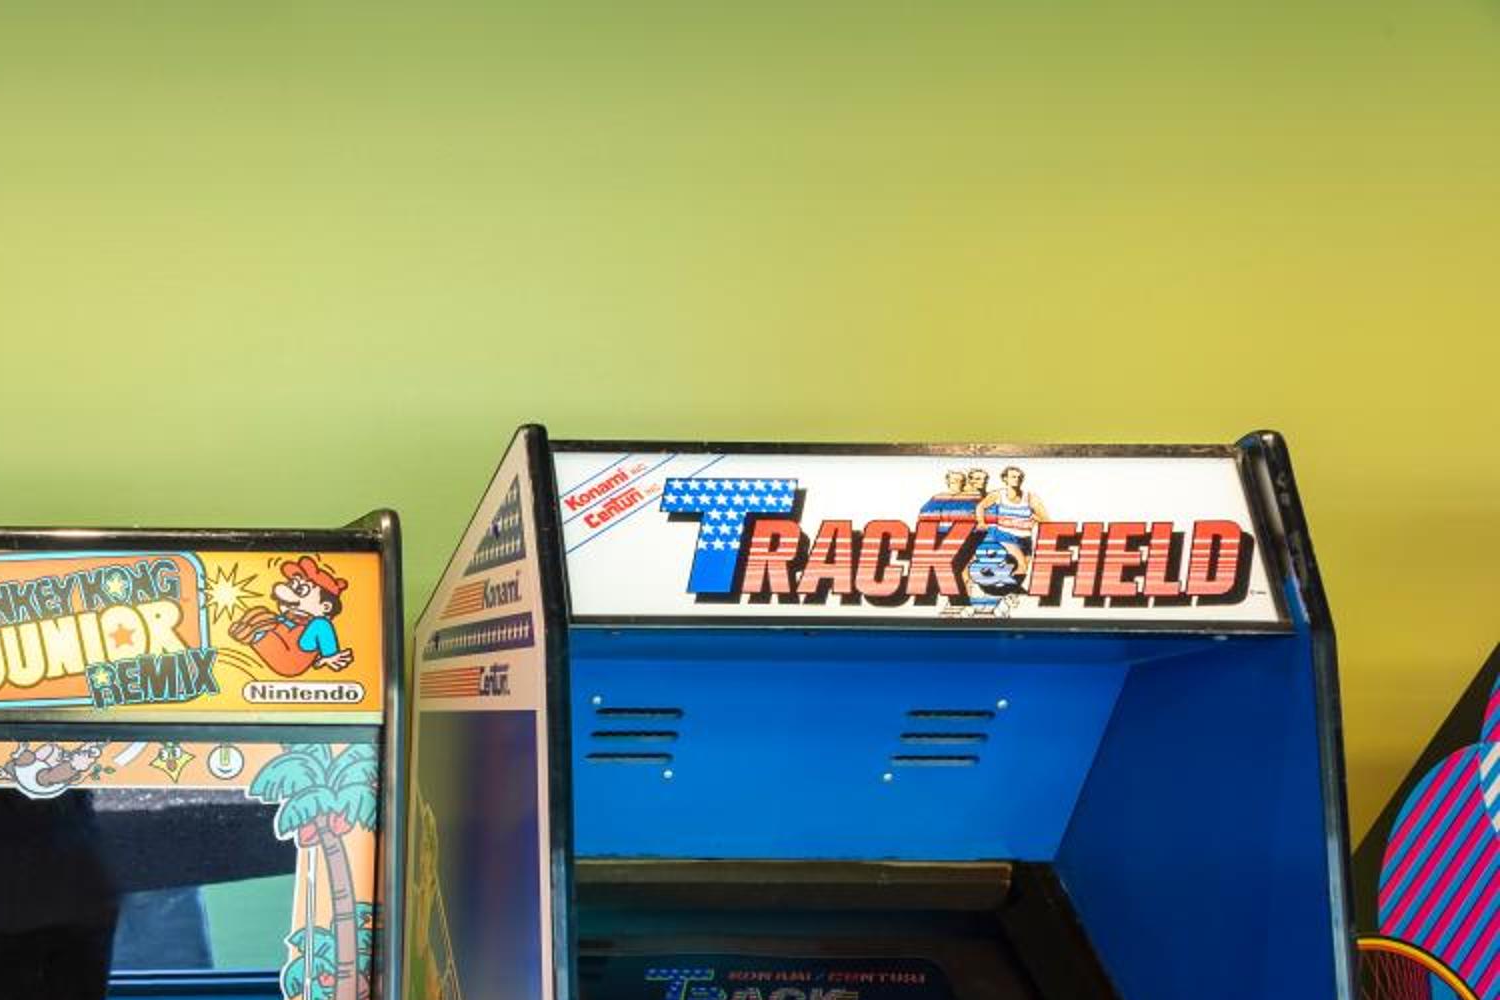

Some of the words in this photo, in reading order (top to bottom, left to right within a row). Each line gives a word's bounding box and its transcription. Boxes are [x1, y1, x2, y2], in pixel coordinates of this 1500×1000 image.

[564, 468, 629, 511] Konami
[660, 477, 978, 600] TRACK
[1028, 520, 1253, 604] FIELD
[74, 559, 182, 612] KONG
[85, 648, 220, 708] REMIX
[250, 685, 360, 701] Nintendo
